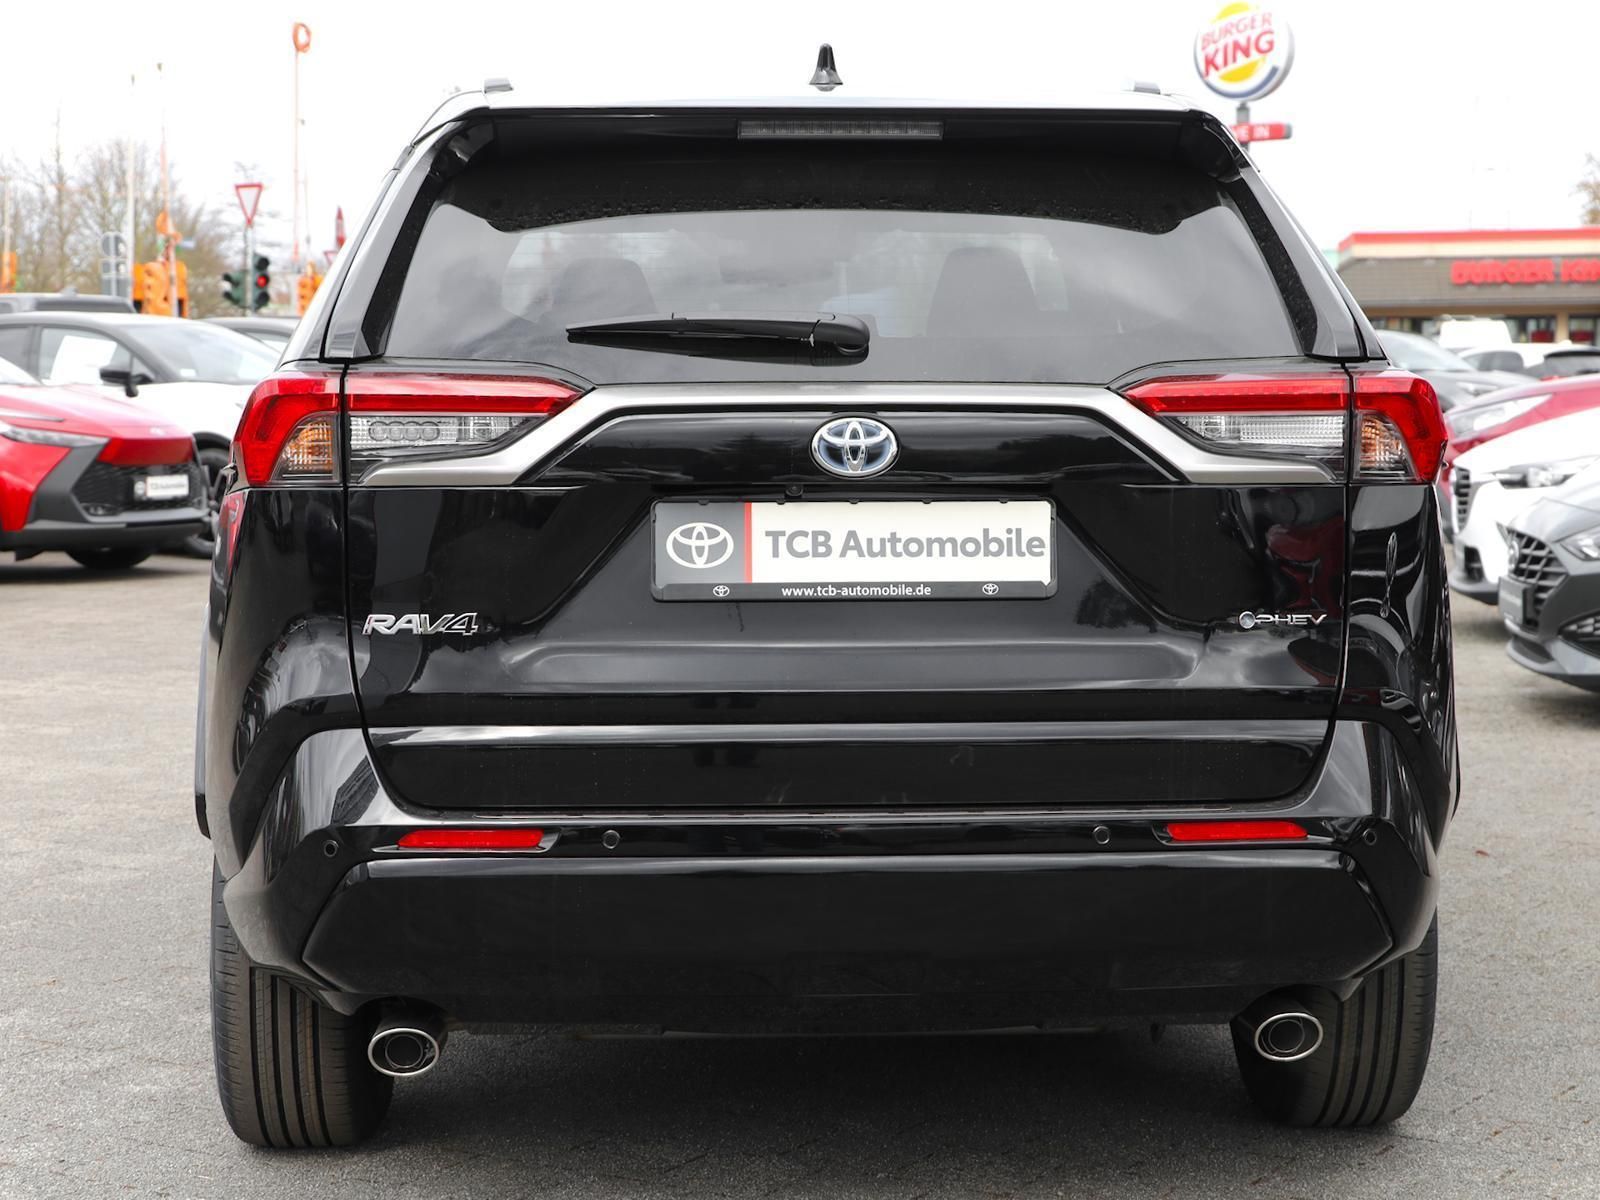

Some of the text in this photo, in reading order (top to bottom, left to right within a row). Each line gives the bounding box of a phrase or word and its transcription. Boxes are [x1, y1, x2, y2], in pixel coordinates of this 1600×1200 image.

[1201, 12, 1272, 51] BURGER
[1203, 30, 1275, 79] KING
[1451, 259, 1555, 285] BURGER
[765, 528, 1046, 558] TCB Automobile
[781, 584, 932, 597] www.tcb-automobile.de
[362, 612, 478, 635] RAV4
[1251, 613, 1327, 626] PHEV
